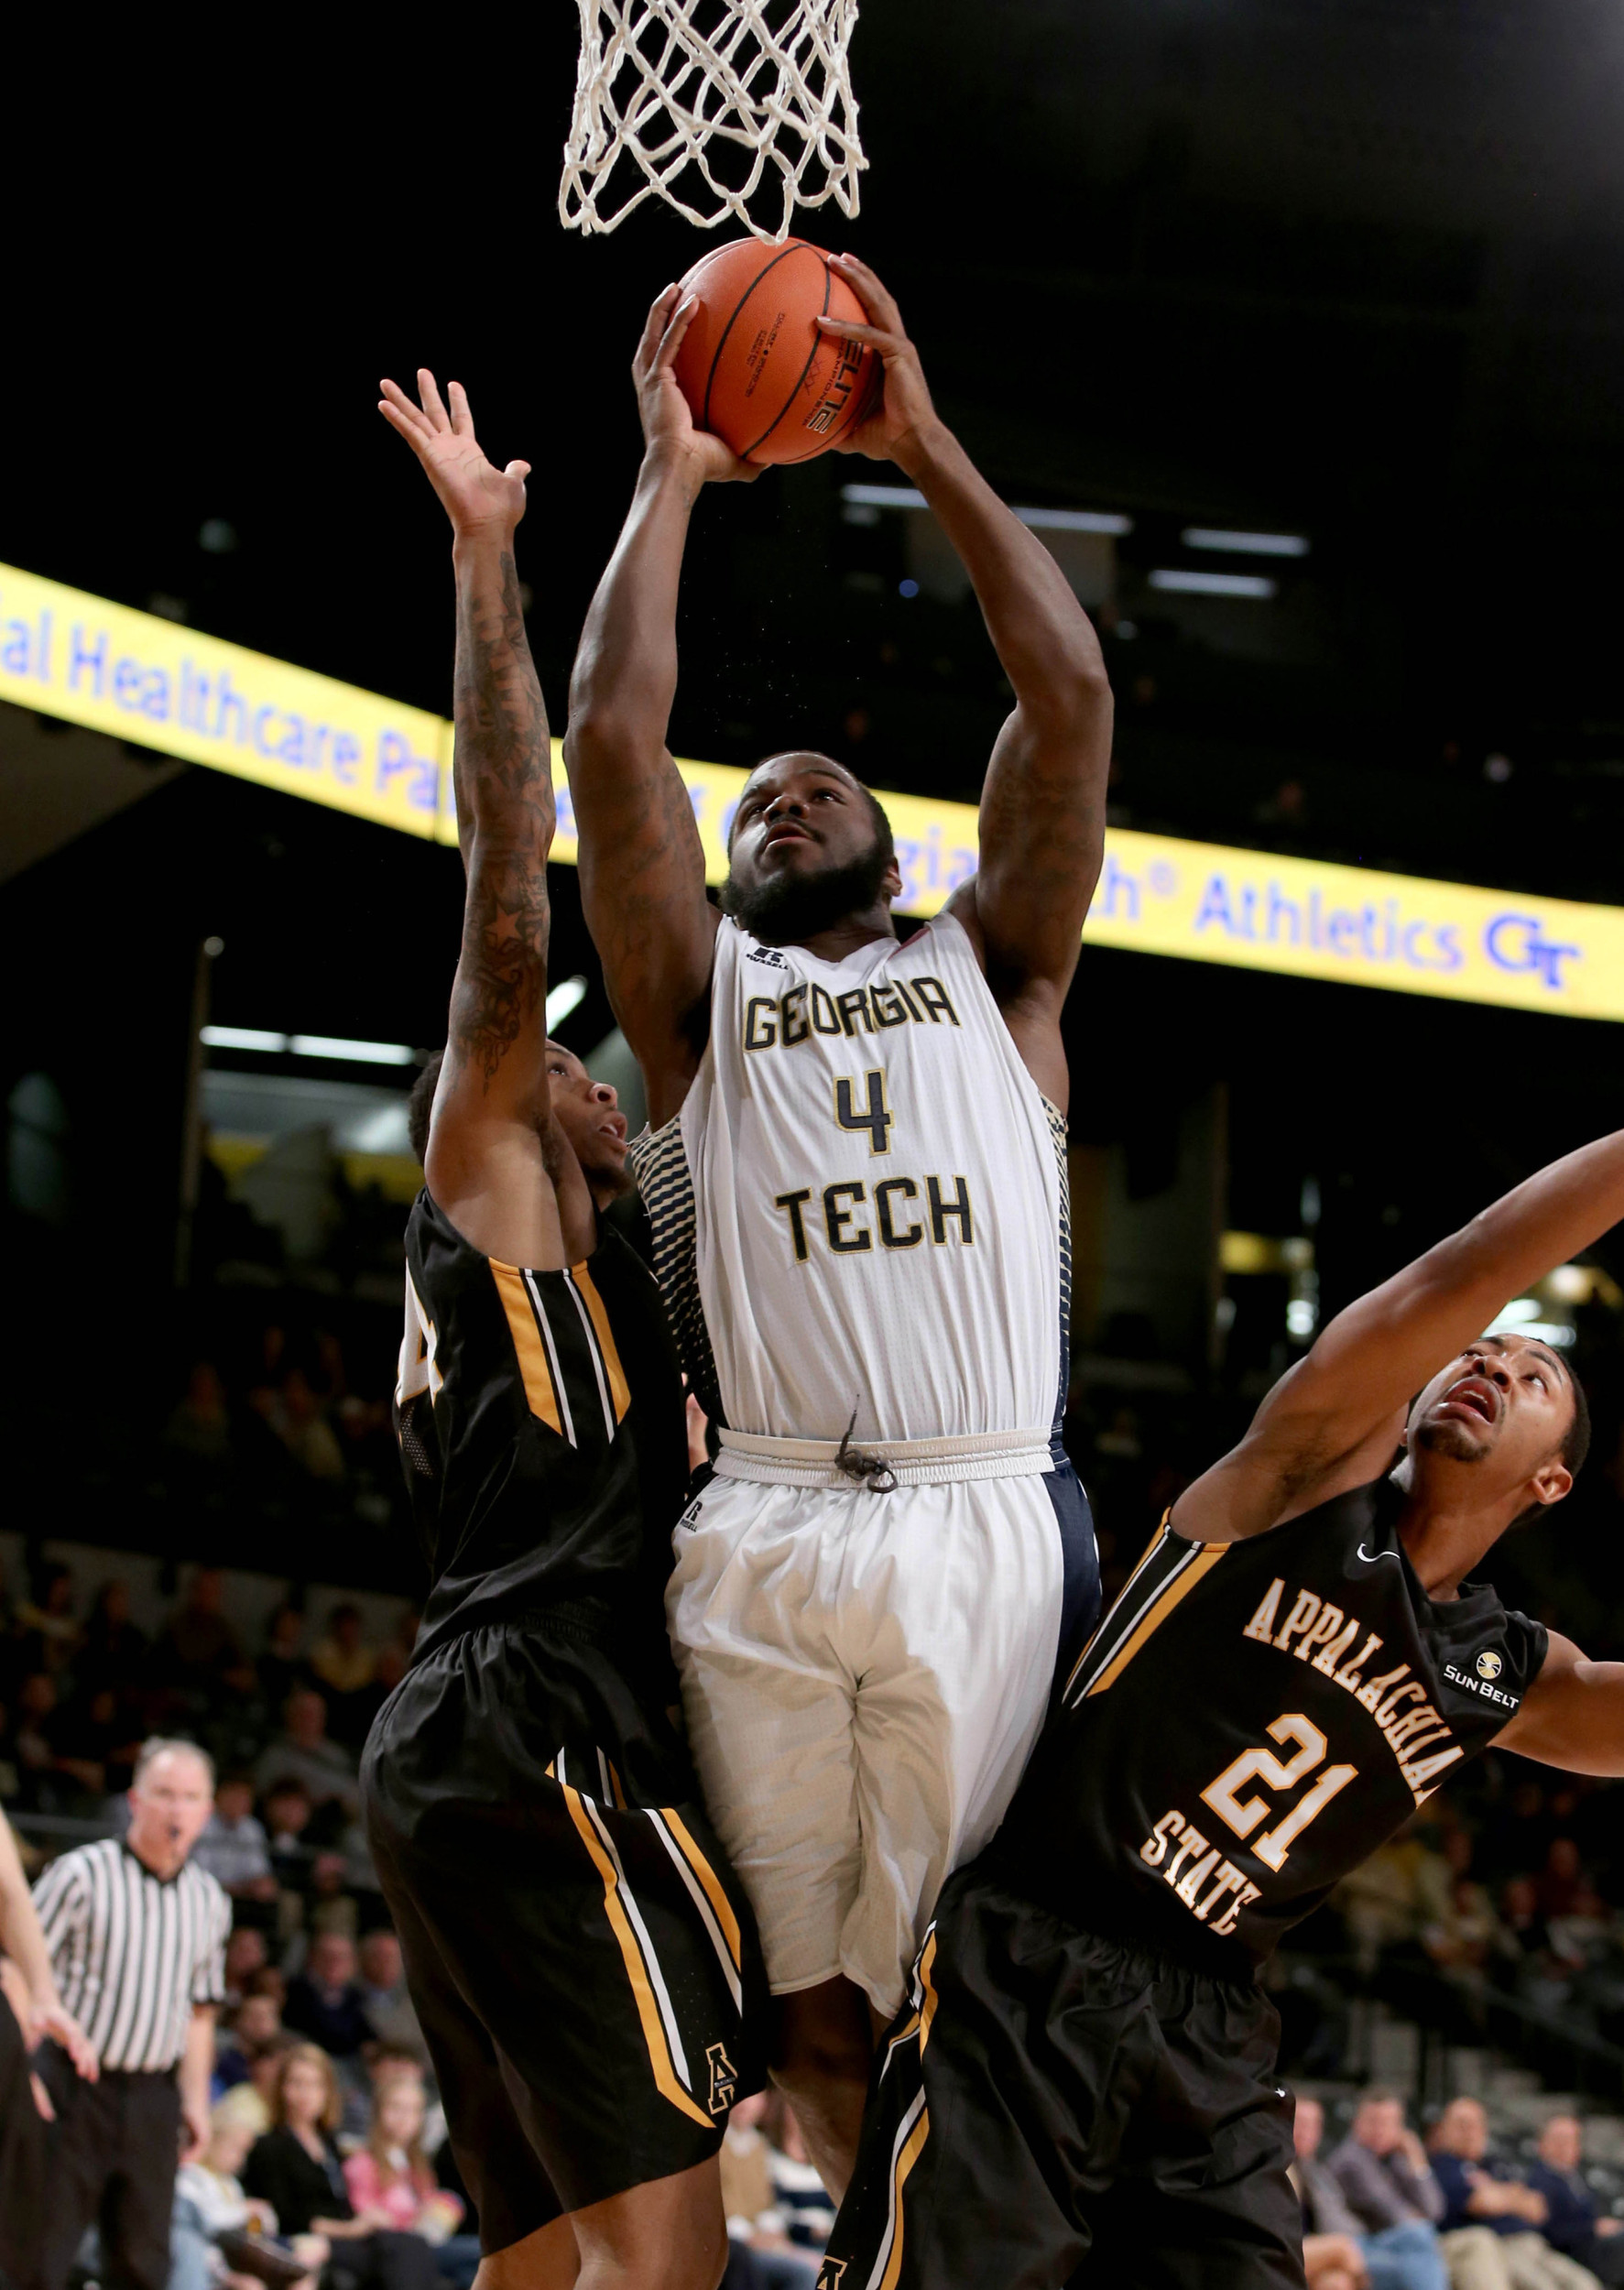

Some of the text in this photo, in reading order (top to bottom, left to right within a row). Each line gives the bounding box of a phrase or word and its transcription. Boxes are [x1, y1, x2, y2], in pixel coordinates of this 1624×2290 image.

[807, 339, 864, 434] ELITE
[68, 623, 363, 785] Healthcare
[1195, 874, 1466, 975] Athletics
[742, 976, 963, 1054] GEORGIA
[832, 1066, 895, 1158] 4
[775, 1173, 975, 1266] TECH
[1242, 1577, 1465, 1808] APPALACHIA
[1443, 1663, 1520, 1709] SUN BELT
[1199, 1713, 1359, 1874] 21
[1139, 1809, 1263, 1936] STATE
